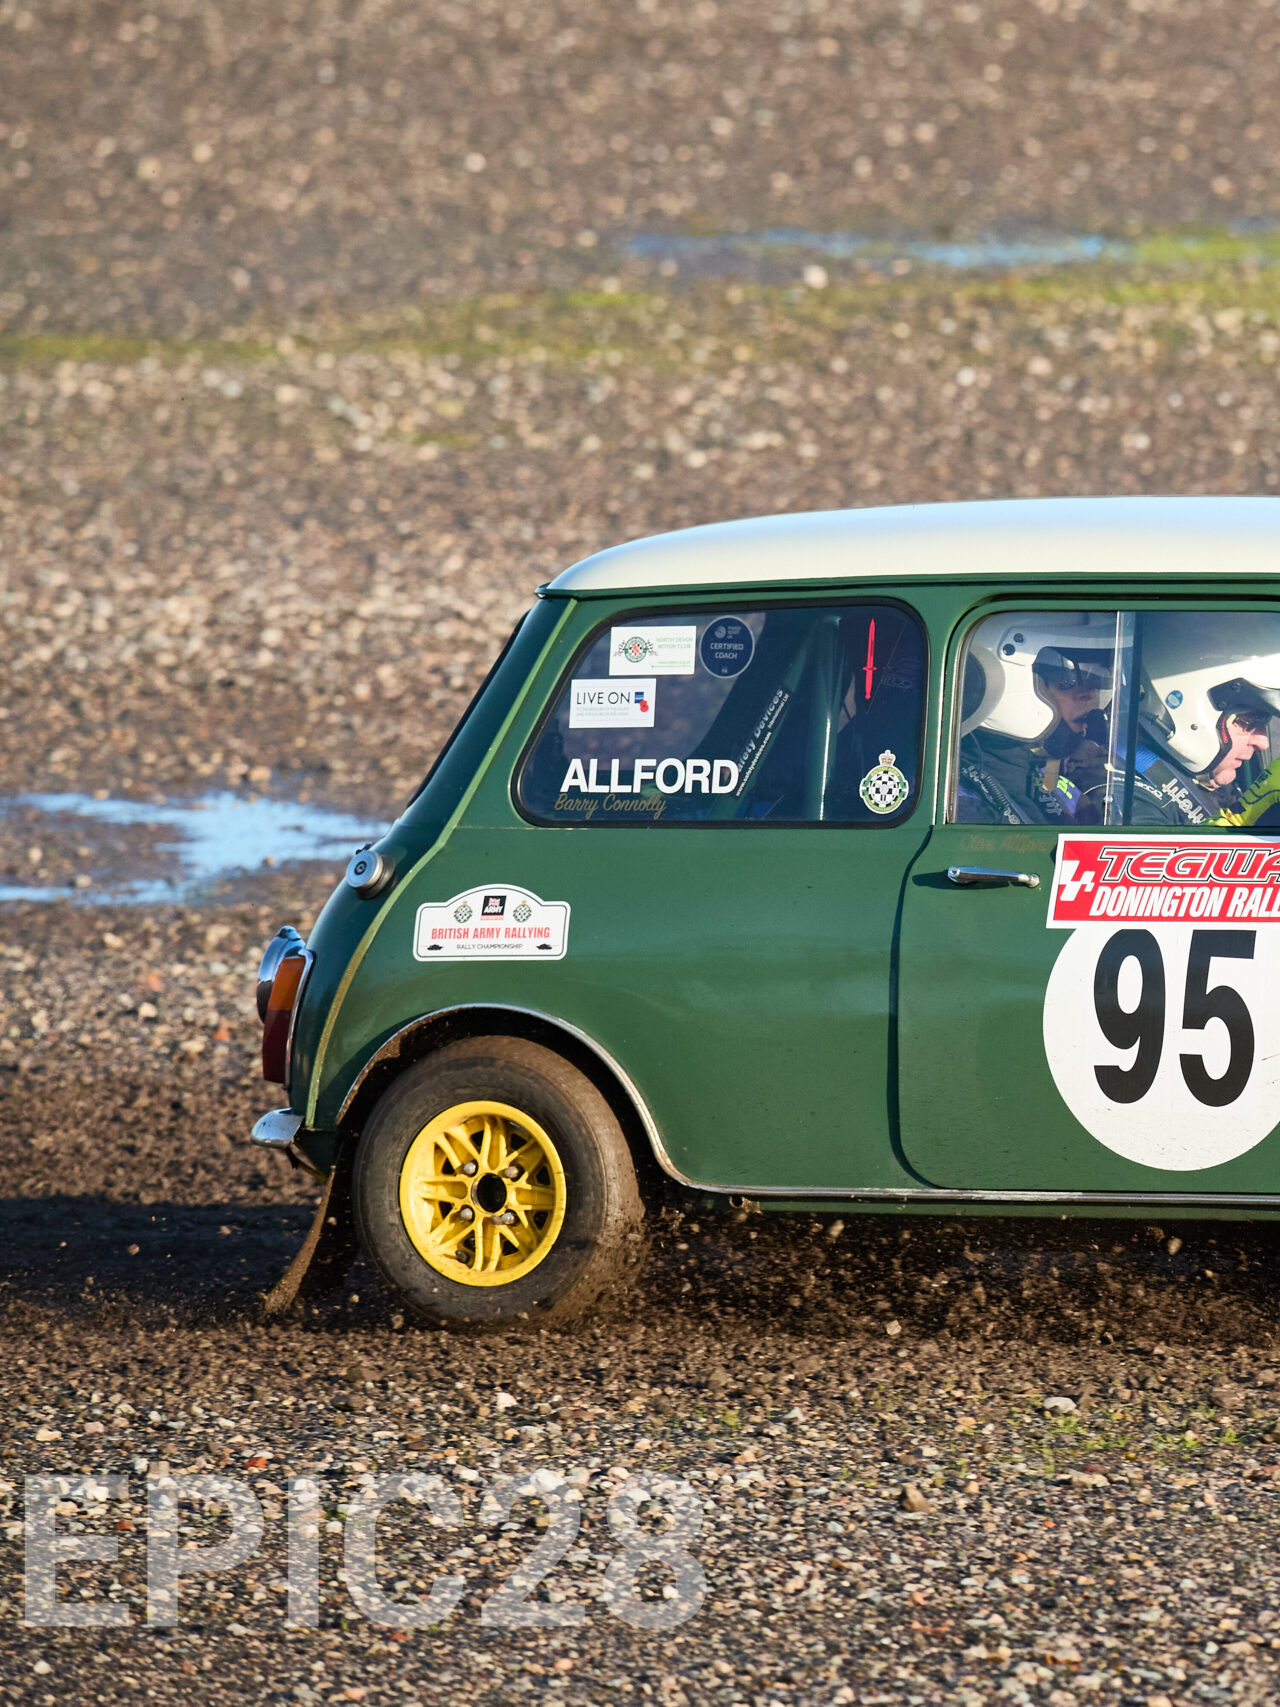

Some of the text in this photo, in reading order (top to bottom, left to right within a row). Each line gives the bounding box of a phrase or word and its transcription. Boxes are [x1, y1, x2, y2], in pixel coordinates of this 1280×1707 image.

[710, 643, 744, 651] CERTIFIED
[714, 652, 737, 660] COACH
[576, 692, 631, 704] LIVE ON
[753, 688, 784, 739] Devices
[560, 758, 739, 794] ALLFORD
[554, 793, 667, 820] Barry Connolly
[483, 904, 504, 915] ARMY
[1089, 885, 1224, 918] DONINGTON
[431, 926, 551, 940] BRITISH ARMY RALLYING
[1093, 928, 1257, 1107] 95
